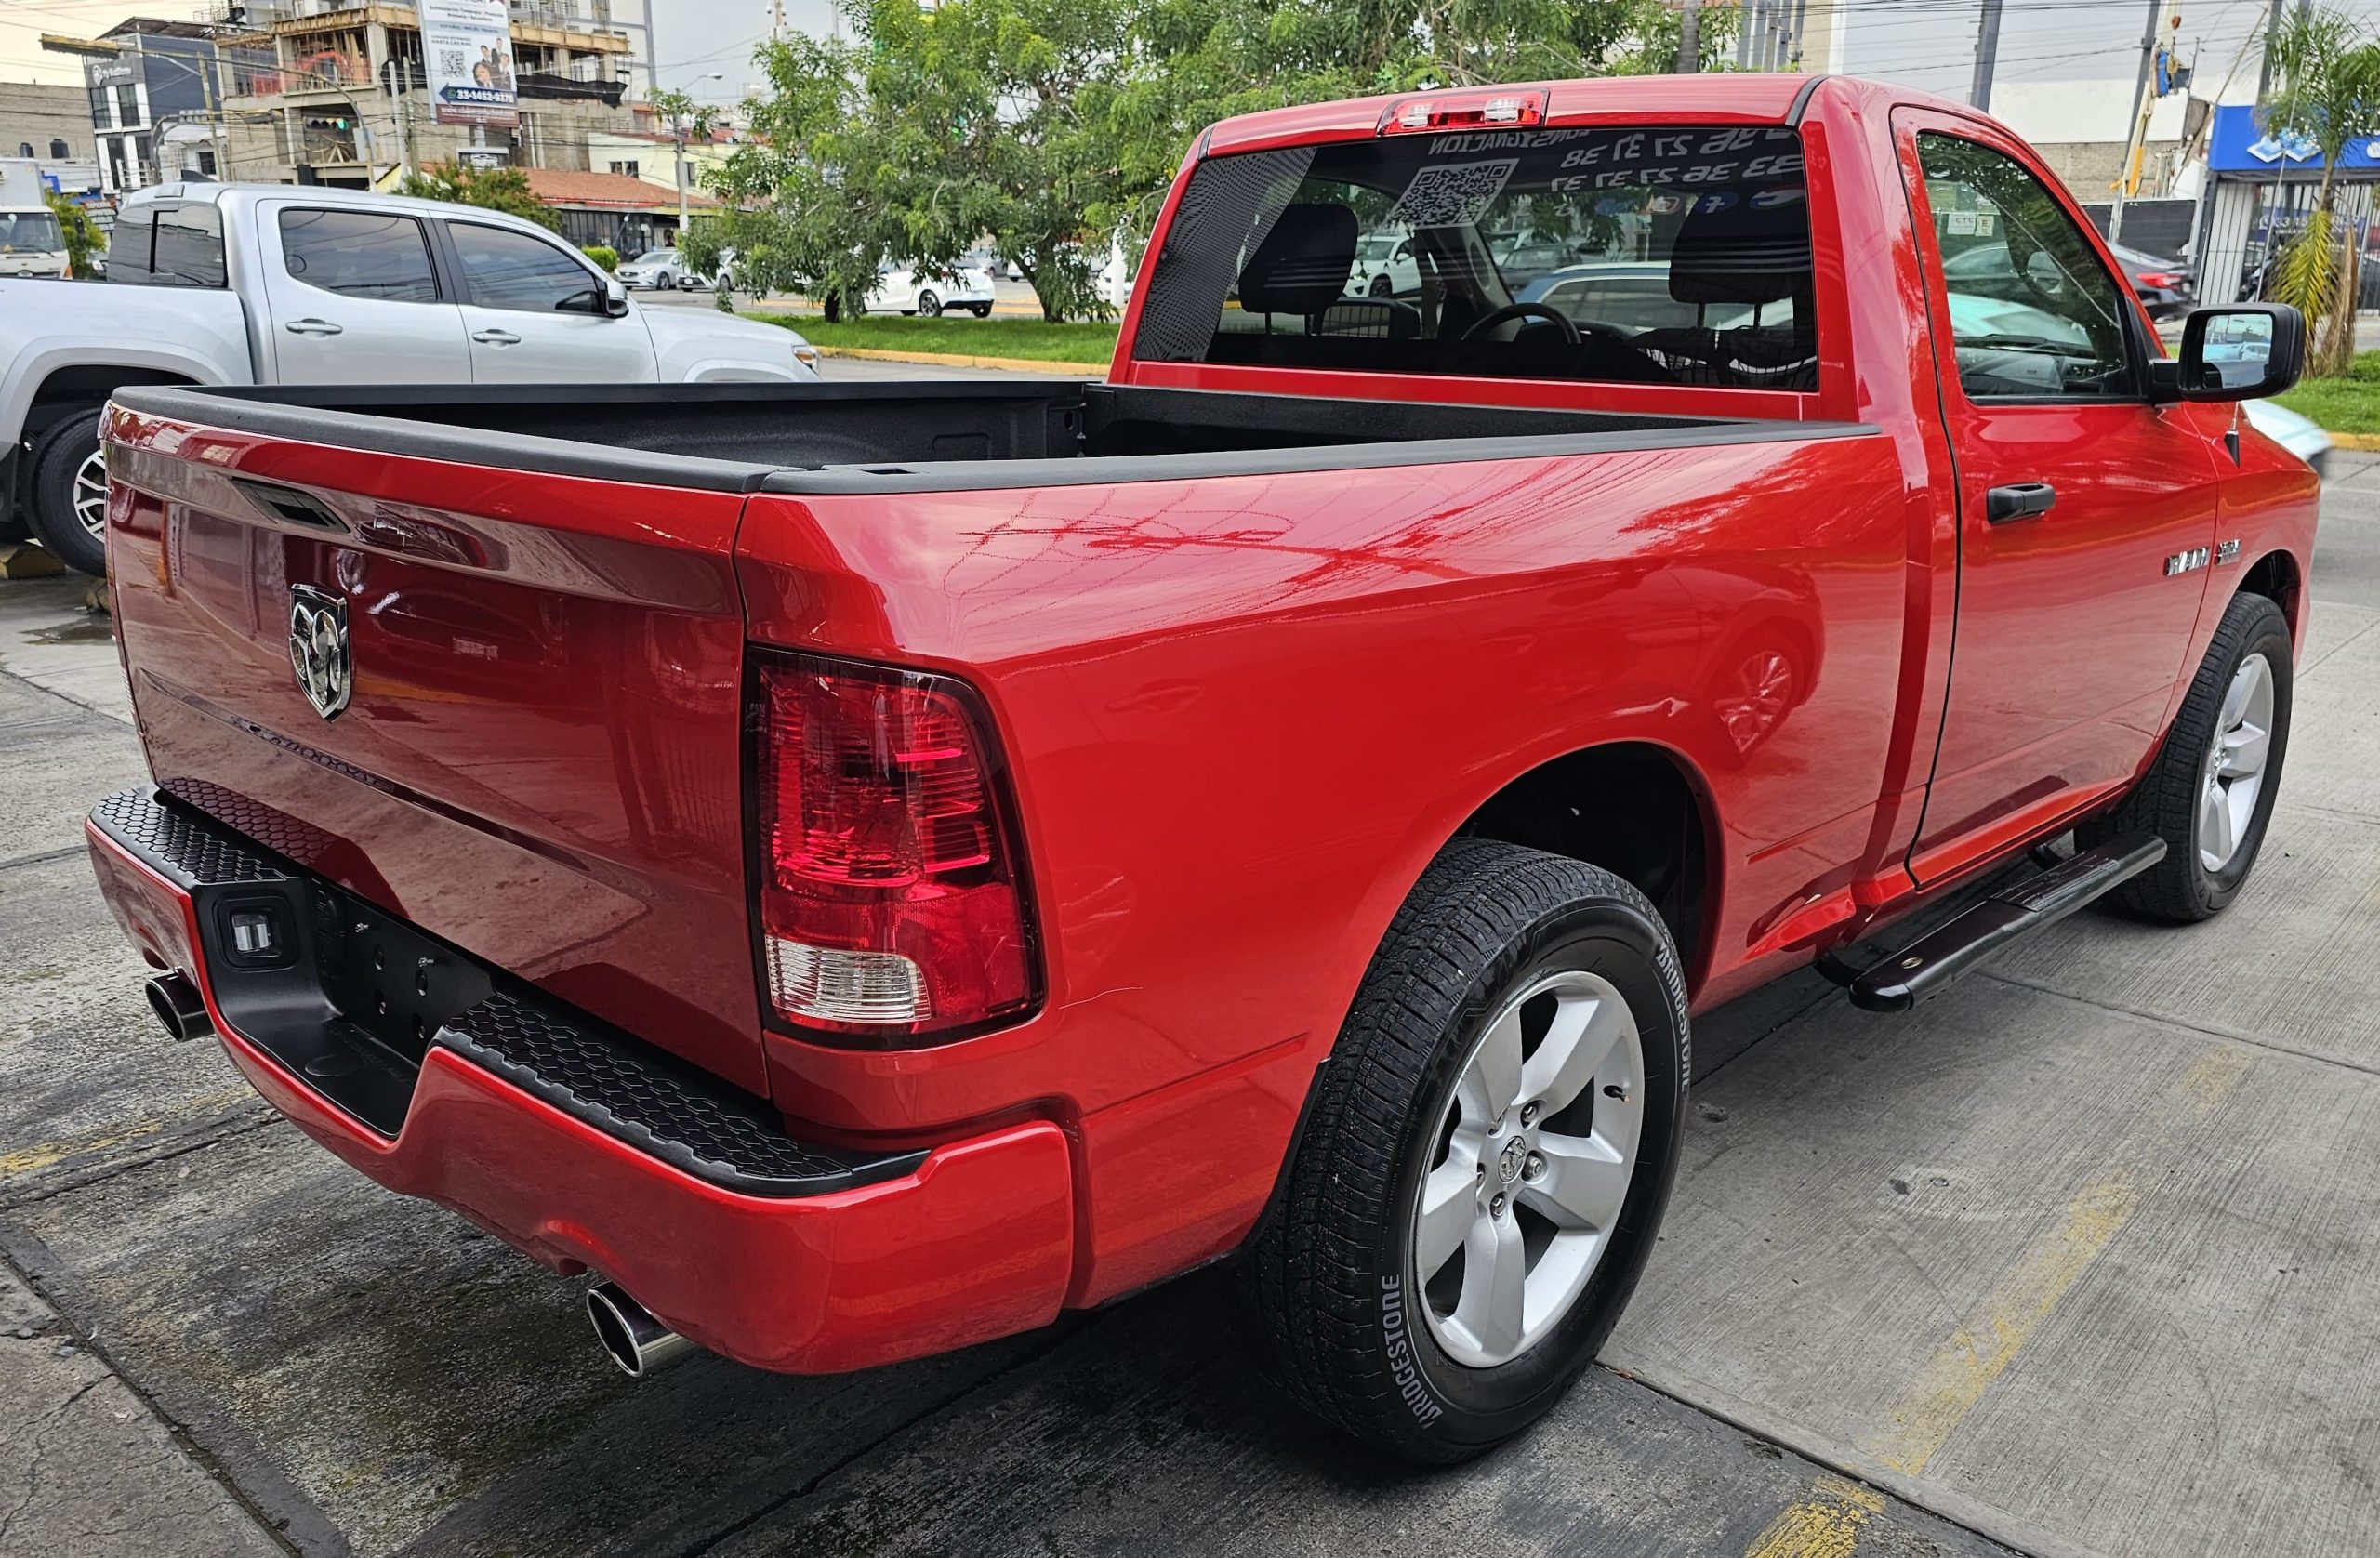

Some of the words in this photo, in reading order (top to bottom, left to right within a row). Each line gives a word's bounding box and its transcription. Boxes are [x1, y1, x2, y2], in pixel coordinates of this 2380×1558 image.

[2167, 547, 2210, 576] RAM
[1656, 942, 1690, 1093] BRIDGESTONE
[1382, 1274, 1443, 1430] BRIDGESTONE
